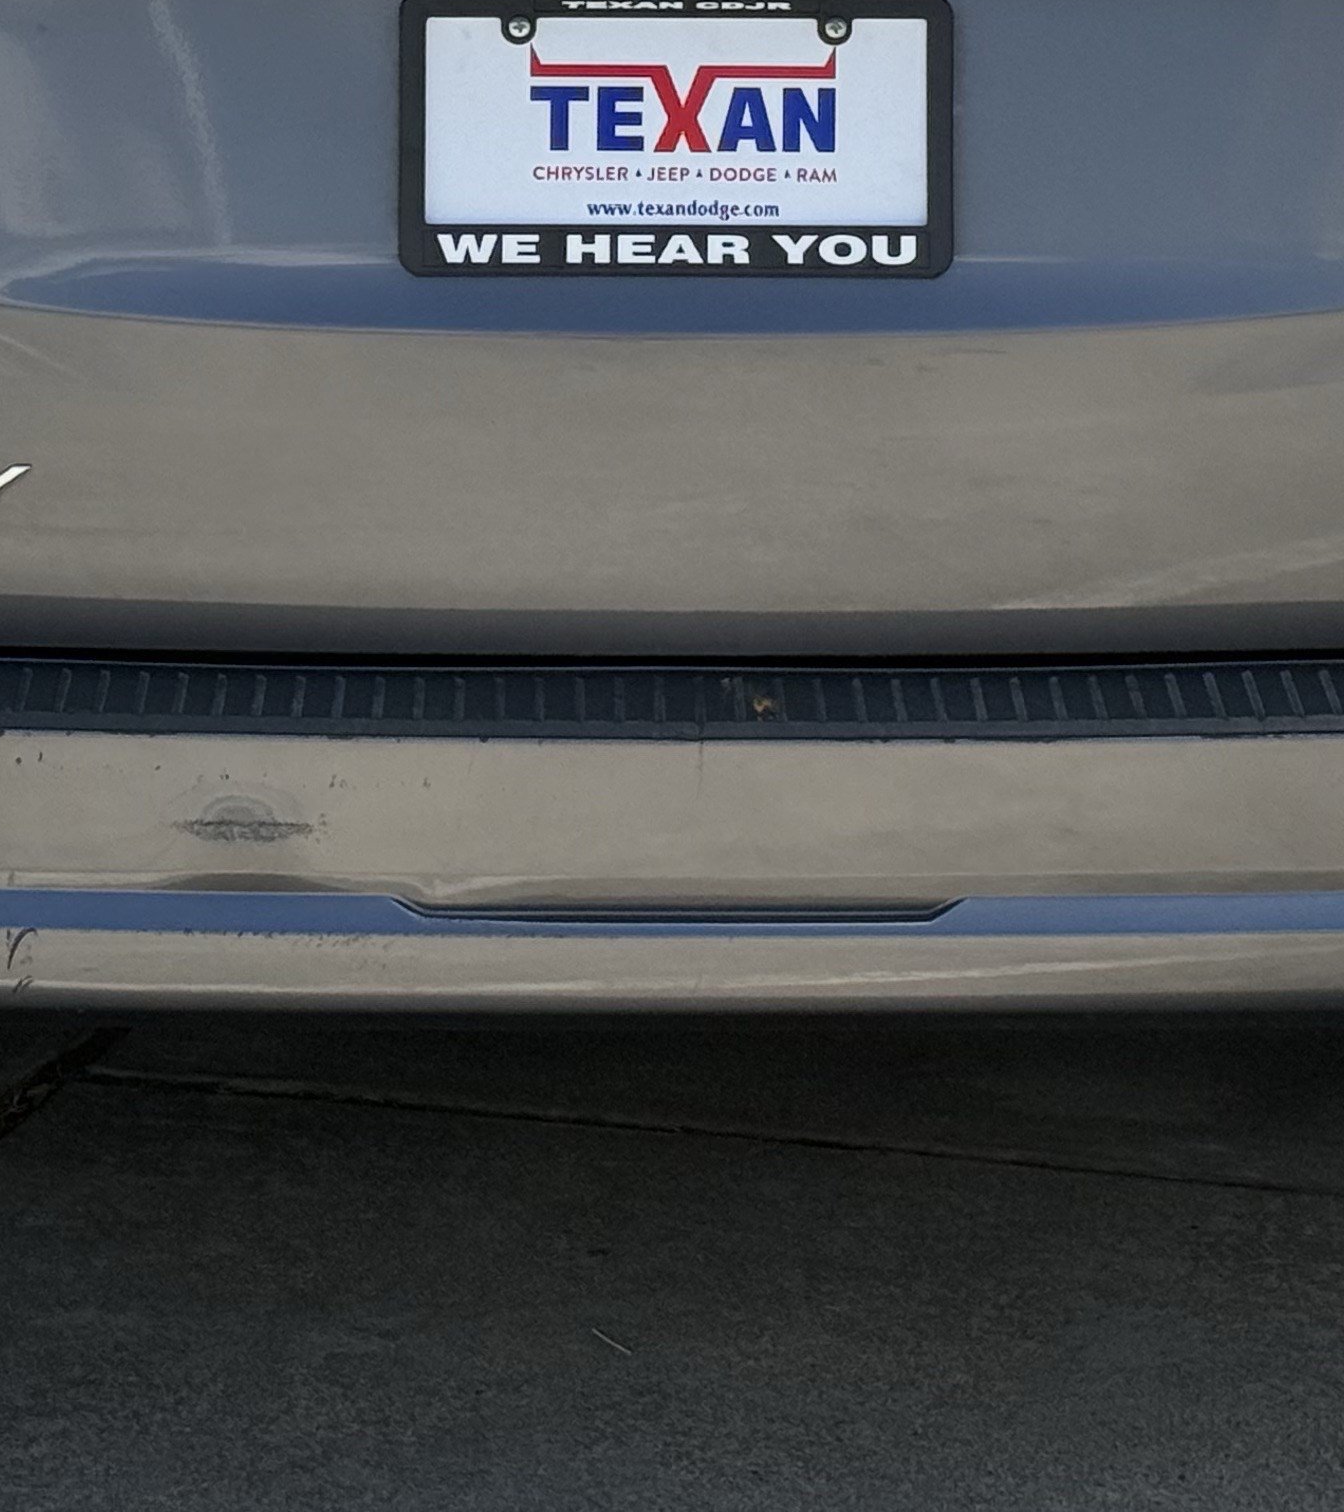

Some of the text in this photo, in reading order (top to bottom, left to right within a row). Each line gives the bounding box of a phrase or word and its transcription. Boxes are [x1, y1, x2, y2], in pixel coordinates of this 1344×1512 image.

[561, 0, 792, 11] TEXAN CDJR
[529, 64, 837, 153] TEXAN
[532, 165, 838, 184] CHRYSLER JEEP DODGE RAM
[586, 199, 780, 221] www.texandodge.com
[437, 233, 919, 266] WE HEAR YOU
